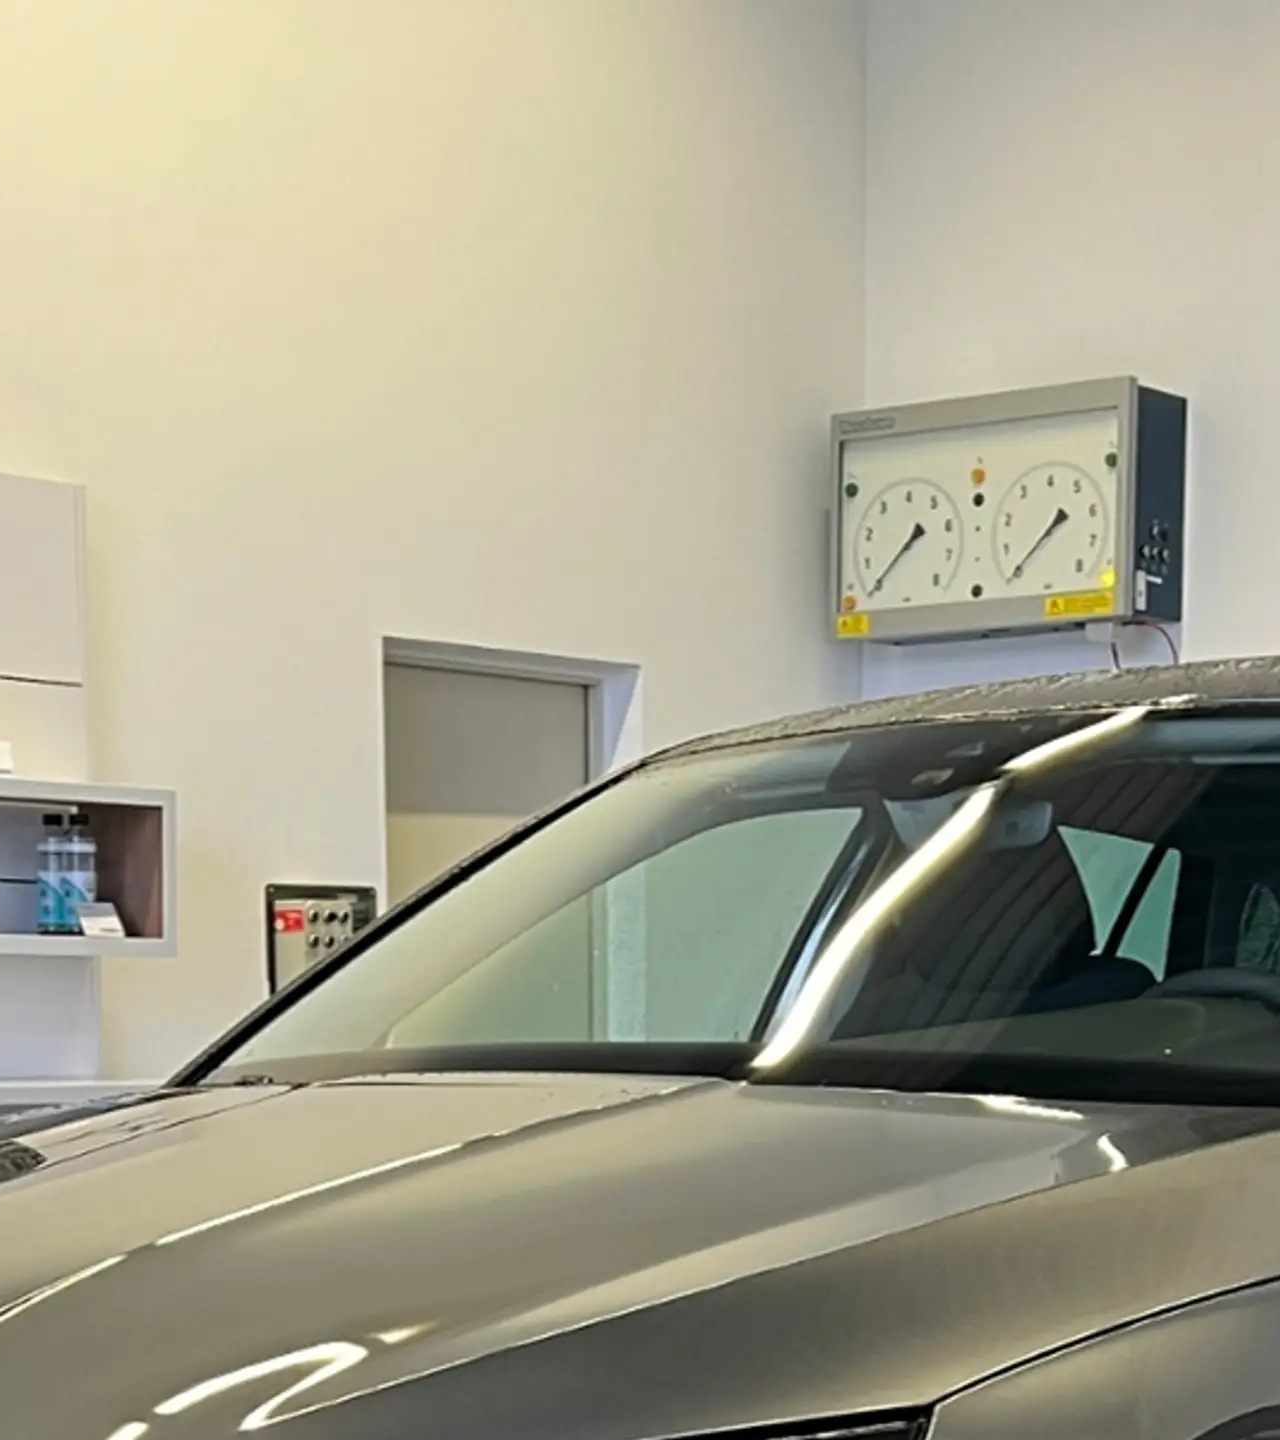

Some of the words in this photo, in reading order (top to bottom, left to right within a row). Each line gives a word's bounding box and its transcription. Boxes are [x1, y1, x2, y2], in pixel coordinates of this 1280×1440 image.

[1047, 474, 1054, 487] 4
[1073, 479, 1081, 493] 5
[906, 490, 912, 503] 4
[1020, 485, 1027, 499] 3
[880, 501, 887, 514] 3
[930, 495, 938, 509] 5
[1088, 504, 1096, 517] 6
[945, 518, 952, 532] 6
[1005, 512, 1013, 527] 2
[866, 527, 873, 541] 2
[1089, 533, 1097, 547] 7
[945, 548, 953, 561] 7
[1003, 543, 1010, 556] 1
[864, 557, 871, 569] 1
[1075, 559, 1083, 572] 8
[933, 573, 940, 586] 8
